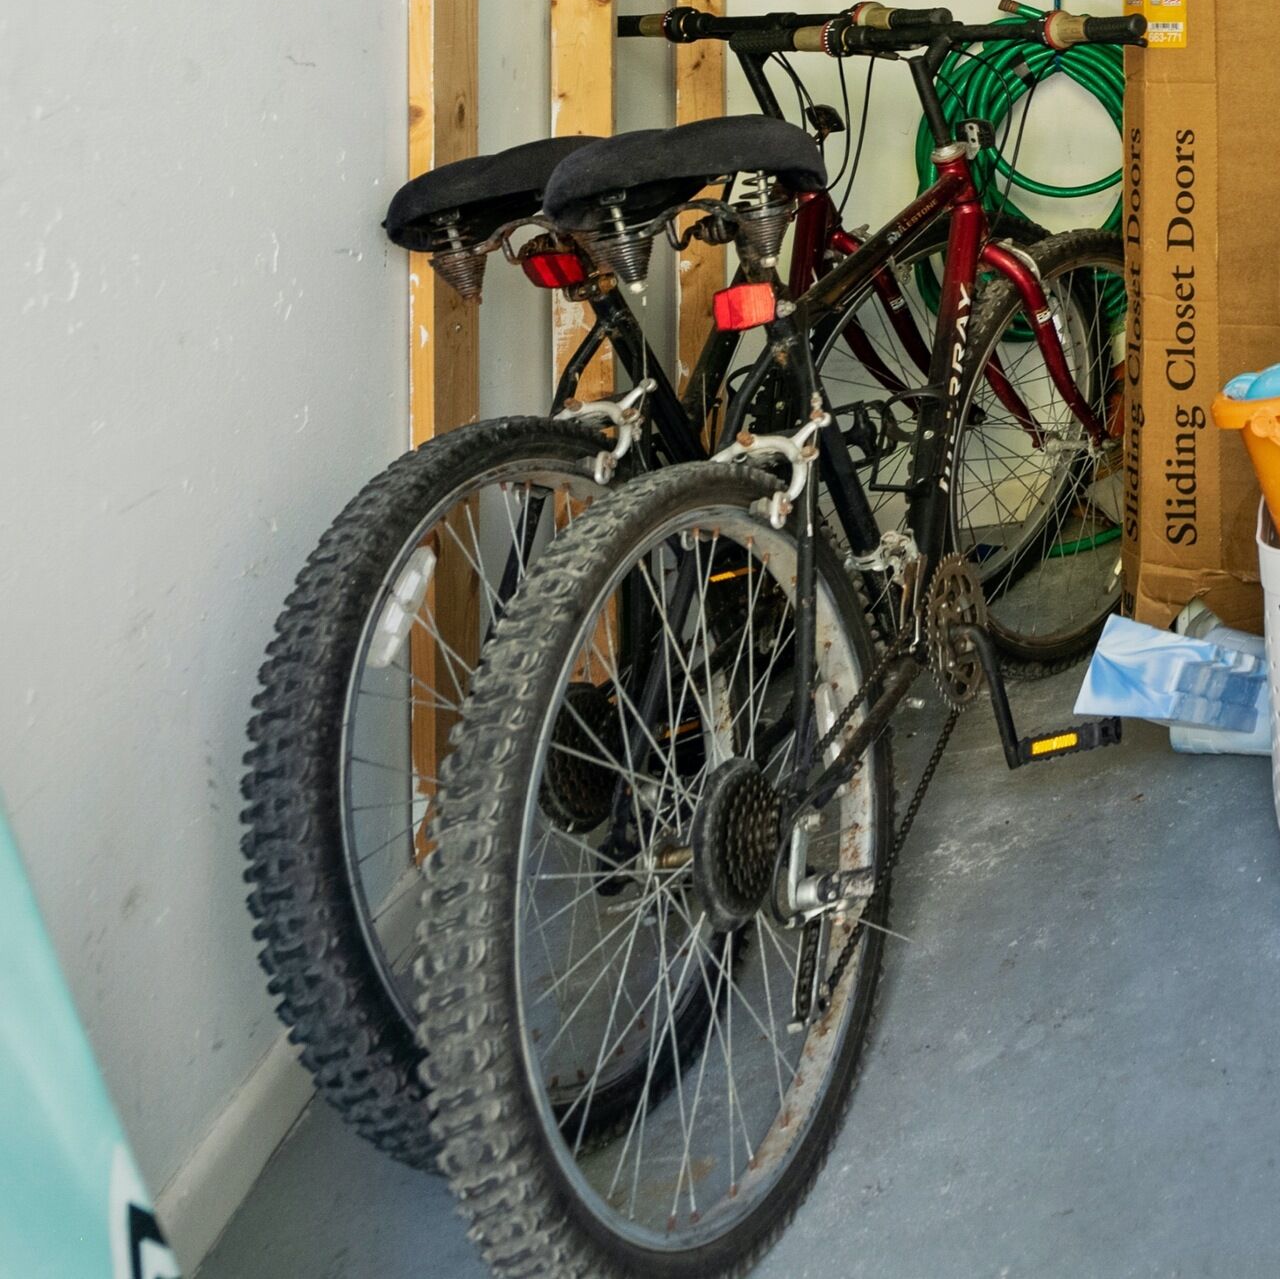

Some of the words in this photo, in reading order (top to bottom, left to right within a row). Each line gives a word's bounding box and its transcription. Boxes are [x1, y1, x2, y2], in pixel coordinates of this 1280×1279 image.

[1126, 126, 1142, 246] Doors
[1166, 128, 1196, 252] Doors
[1127, 260, 1142, 388] Closet
[1165, 265, 1196, 391] Closet
[1126, 402, 1145, 542] Sliding
[1165, 403, 1207, 546] Sliding
